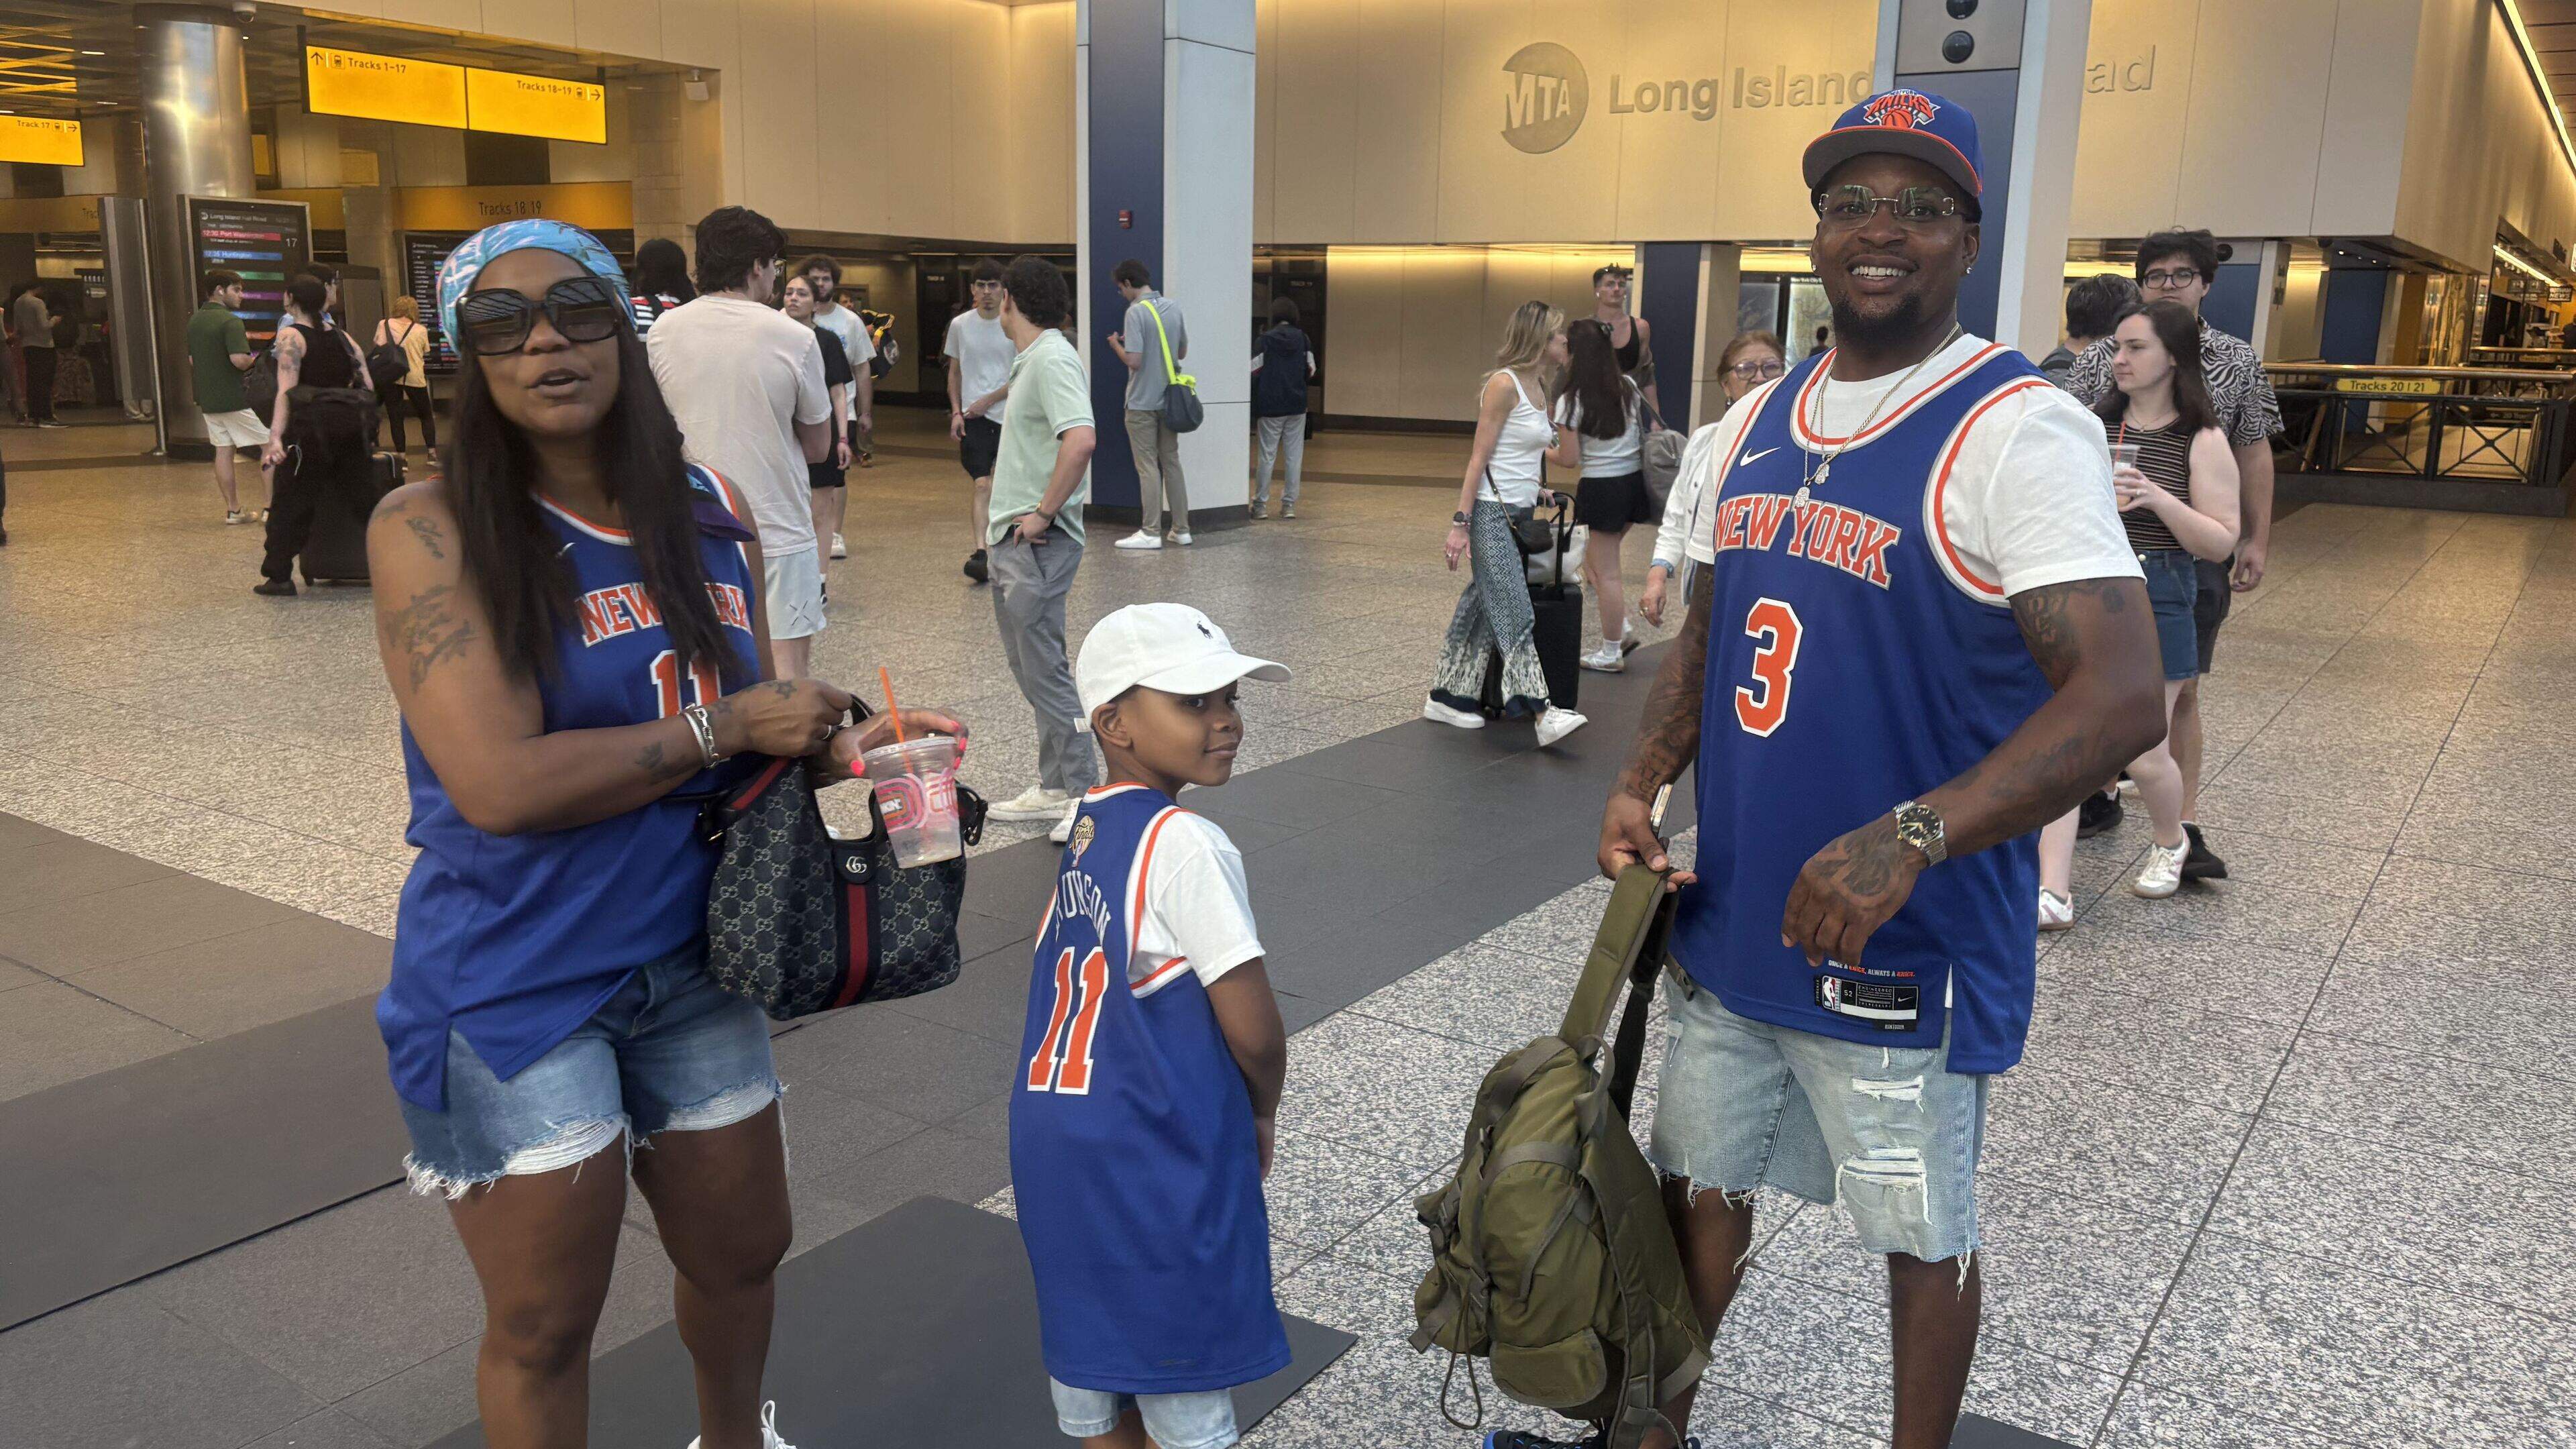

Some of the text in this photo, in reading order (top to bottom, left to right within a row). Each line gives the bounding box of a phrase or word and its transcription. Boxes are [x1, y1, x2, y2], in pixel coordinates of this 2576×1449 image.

[348, 58, 381, 70] Tracks
[517, 80, 572, 95] Tracks 18-19
[1501, 44, 2155, 131] MTA Long Island ad
[1865, 94, 1933, 119] KNICKS
[479, 201, 541, 215] Tracks 18 19
[286, 238, 297, 248] 17
[2351, 381, 2386, 390] Tracks
[2390, 382, 2404, 392] 20
[2414, 382, 2424, 392] 21
[1714, 494, 1902, 591] NEW YORK
[575, 582, 753, 648] NEW RK
[1735, 597, 1804, 738] 3
[649, 649, 722, 719] 11
[1055, 870, 1111, 947] RUNSON
[1868, 968, 1890, 977] ALWAYS
[1843, 989, 1853, 998] 52
[1028, 946, 1109, 1095] 11
